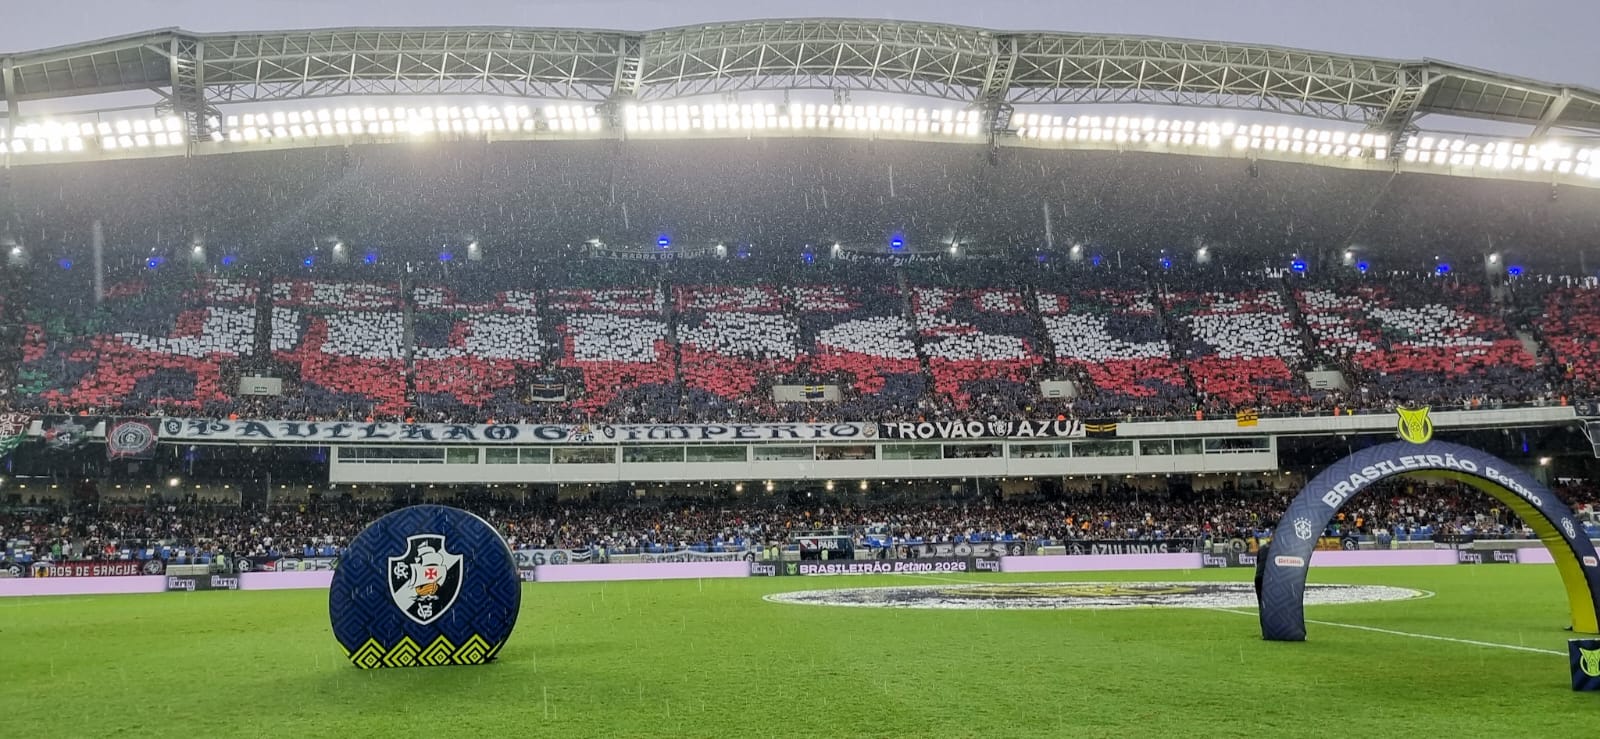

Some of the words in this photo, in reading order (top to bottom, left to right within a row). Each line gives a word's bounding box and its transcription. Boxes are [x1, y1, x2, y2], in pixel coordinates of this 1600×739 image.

[1322, 453, 1477, 509] BRASILEIRÃO
[1486, 466, 1542, 507] Betano
[75, 566, 91, 577] DE
[92, 564, 138, 577] SANGUE
[800, 561, 891, 574] BRASILEIRÃO
[894, 560, 932, 571] Betano
[935, 561, 966, 571] 2026
